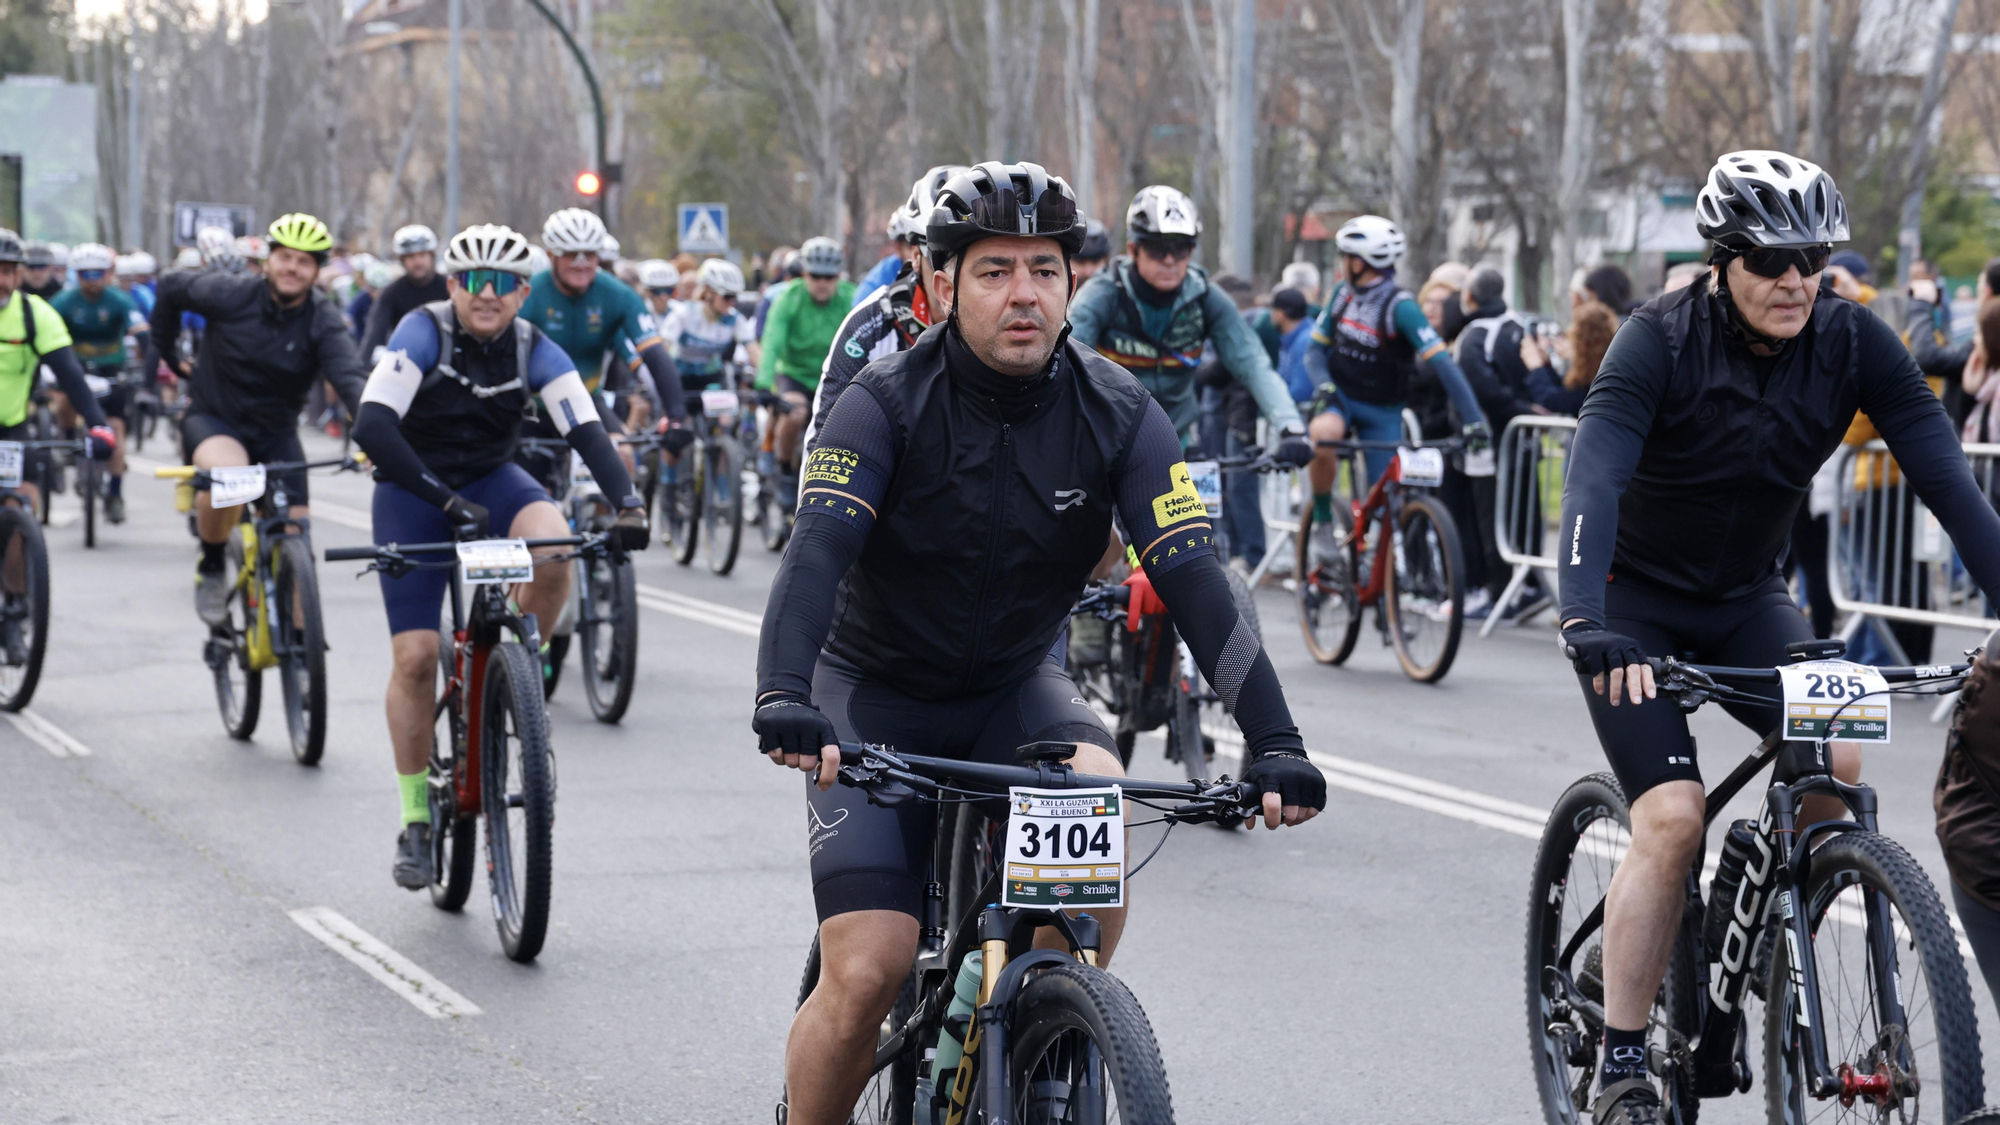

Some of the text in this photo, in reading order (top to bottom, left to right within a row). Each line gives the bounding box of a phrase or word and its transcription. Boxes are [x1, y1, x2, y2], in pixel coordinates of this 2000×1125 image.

[809, 453, 859, 468] ITAN
[808, 464, 854, 477] SERT
[807, 473, 839, 482] MERIA
[1164, 495, 1195, 508] Hello
[1804, 673, 1866, 699] 285
[1853, 722, 1884, 732] Smilke
[1040, 798, 1099, 807] XXI LA GUZMÁN
[1061, 808, 1088, 816] BUENO
[809, 829, 839, 849] NTAÑISMO
[1019, 822, 1111, 859] 3104
[1083, 883, 1117, 895] Smilke
